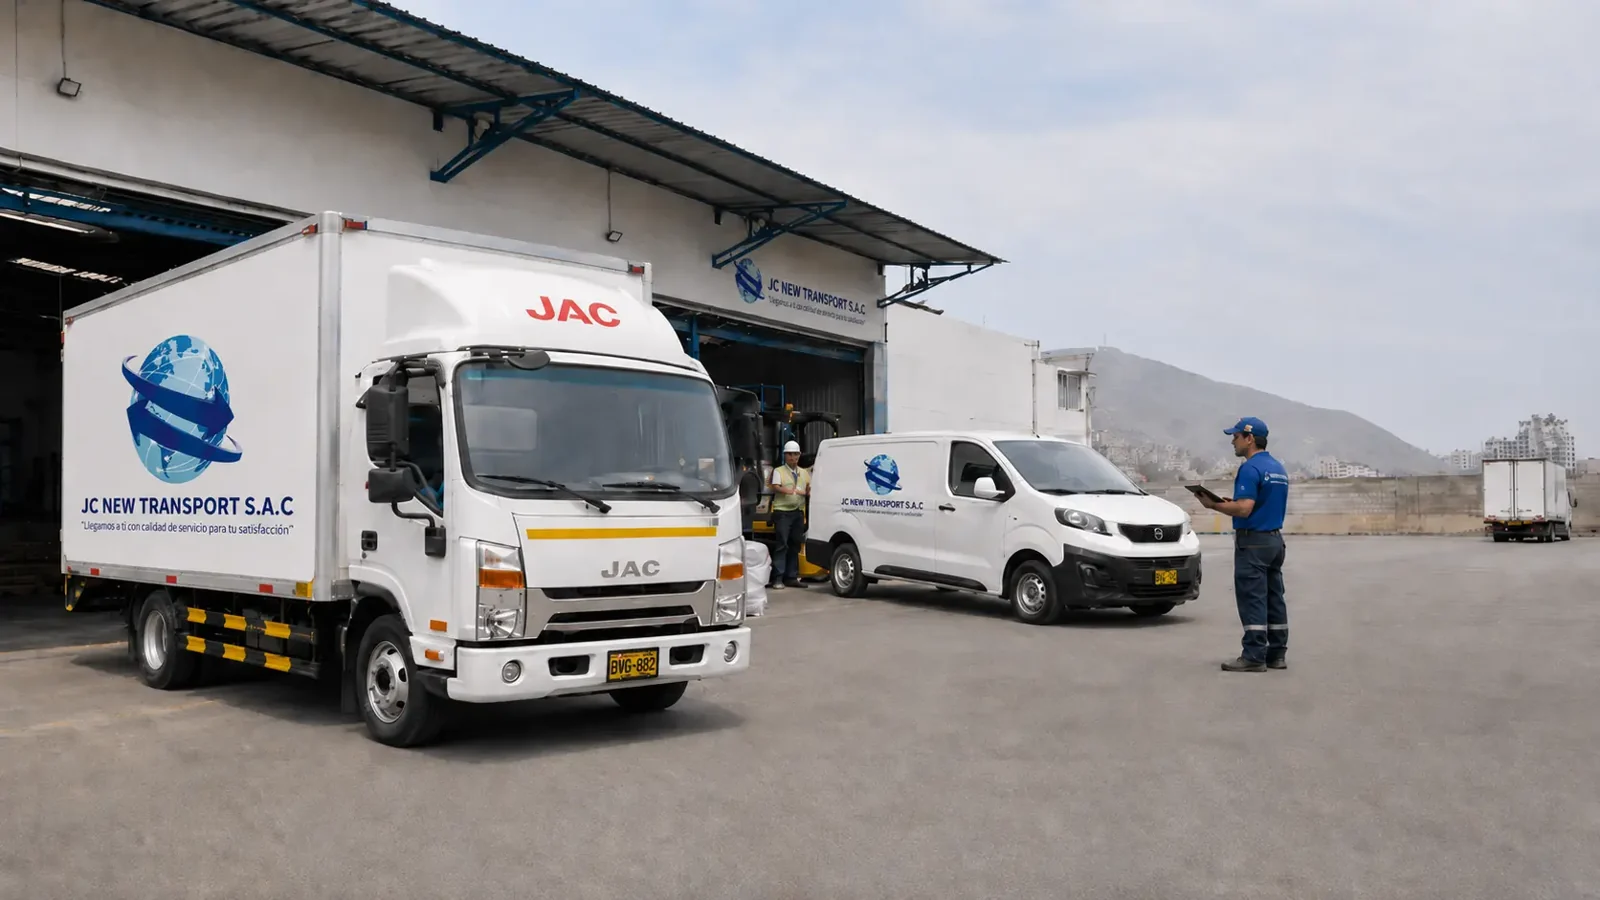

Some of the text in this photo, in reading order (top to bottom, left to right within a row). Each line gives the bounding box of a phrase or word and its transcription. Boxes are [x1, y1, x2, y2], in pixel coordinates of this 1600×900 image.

[768, 278, 780, 292] JC
[781, 281, 801, 298] NEW
[802, 287, 847, 310] TRANSPORT
[525, 295, 621, 328] JAC
[81, 496, 294, 516] JC NEW TRANSPORT S.A.C
[841, 498, 849, 506] JC
[865, 499, 904, 509] TRANSPORT
[115, 523, 121, 531] a
[121, 521, 127, 532] ti
[127, 523, 141, 532] con
[141, 521, 167, 532] calidad
[167, 522, 177, 533] de
[178, 522, 208, 533] servicio
[208, 524, 227, 535] para
[228, 523, 237, 534] tu
[601, 560, 660, 578] JAC
[611, 657, 656, 675] BVG-882
